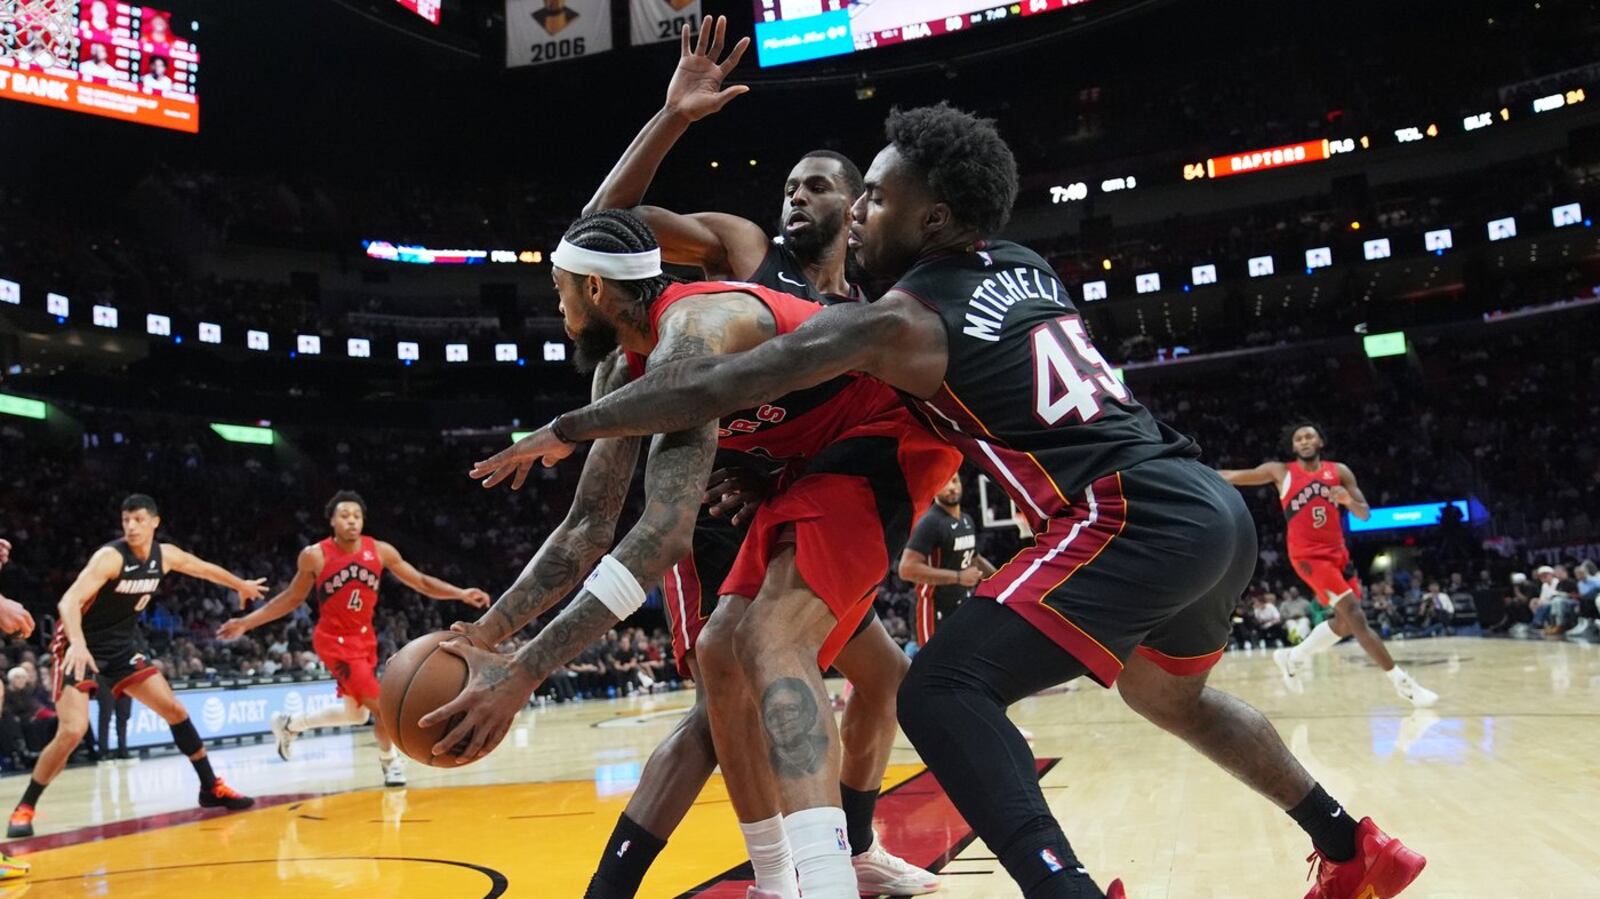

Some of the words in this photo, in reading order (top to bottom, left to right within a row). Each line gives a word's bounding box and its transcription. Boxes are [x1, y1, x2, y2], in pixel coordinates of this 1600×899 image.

[902, 22, 932, 41] MIA
[531, 37, 586, 63] 2006
[12, 73, 70, 102] BANK
[1500, 107, 1510, 121] 1
[1426, 124, 1438, 137] 4
[1360, 136, 1369, 149] 1
[1183, 162, 1205, 181] 54
[1230, 147, 1306, 171] RAPTORS
[1049, 182, 1088, 204] 7:40
[963, 267, 1066, 342] MITCHELL
[1031, 315, 1129, 426] 45
[1291, 483, 1338, 511] RAPTO
[1312, 506, 1327, 529] 5
[115, 578, 160, 594] MIAMI
[134, 594, 151, 611] 0
[347, 589, 363, 612] 4
[228, 700, 267, 723] AT&T
